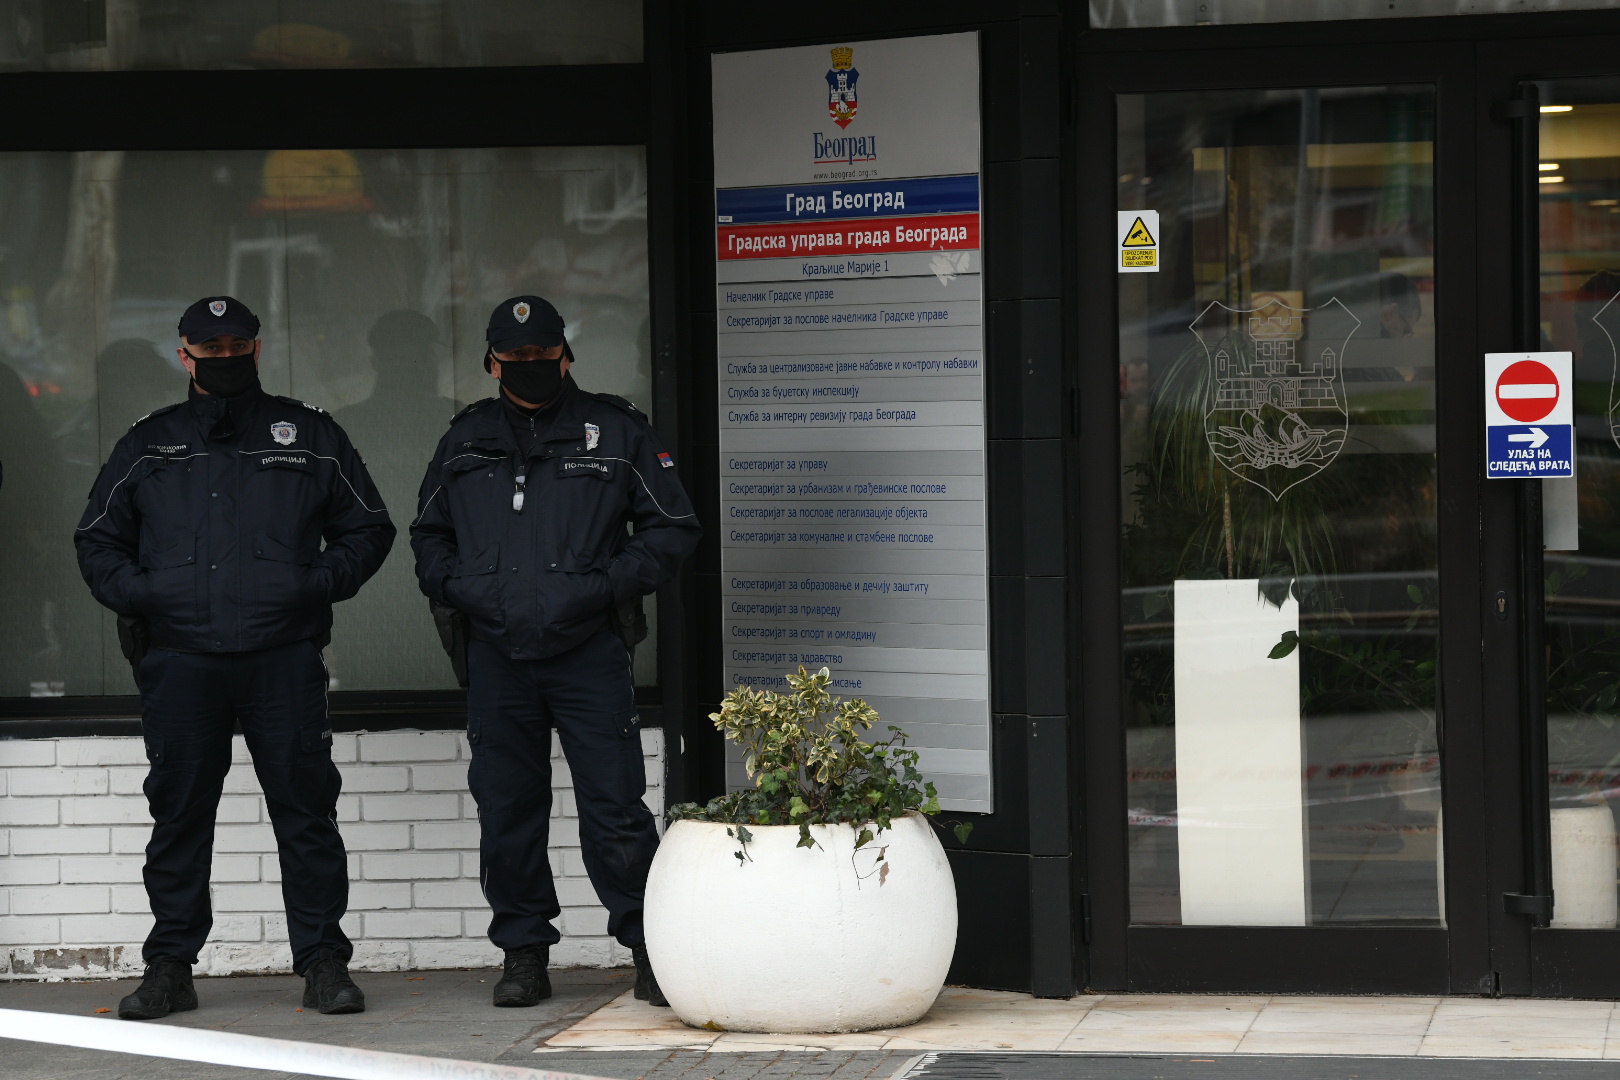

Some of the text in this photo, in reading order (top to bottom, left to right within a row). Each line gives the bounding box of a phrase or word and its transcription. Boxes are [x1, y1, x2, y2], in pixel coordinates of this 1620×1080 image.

[813, 132, 876, 164] Београд
[814, 169, 877, 180] www.beograd.org.rs
[786, 190, 905, 215] Град Београд
[728, 225, 967, 254] Градска управа града Београда
[802, 260, 889, 277] Краљице Марије 1
[727, 289, 834, 303] Начелник Градске управе
[727, 310, 948, 329] Секретаријат за послове начелника Градске управе
[728, 363, 757, 376] Служба
[759, 365, 768, 374] за
[770, 362, 833, 374] централизоване
[836, 360, 857, 374] јавне
[860, 359, 892, 371] набавке
[903, 359, 940, 372] контролу
[943, 358, 978, 369] набавки
[728, 385, 859, 400] Служба за буџетску инспекцију
[728, 408, 915, 424] Служба за интерну ревизију града Београда
[262, 456, 307, 465] ПОЛИЦИЈА
[1508, 449, 1551, 458] УЛАЗ НА
[565, 462, 608, 472] ПОЛИЦИЈА
[729, 459, 827, 472] Секретаријат за управу
[1490, 461, 1570, 472] СЛЕДЕЋА ВРАТА
[730, 483, 784, 496] Секретаријат
[787, 484, 796, 493] за
[798, 483, 843, 495] урбанизам
[854, 483, 908, 496] грађевинске
[911, 484, 946, 493] послове
[730, 507, 927, 520] Секретаријат за послове легализације објекта
[731, 531, 785, 544] Секретаријат
[788, 532, 797, 541] за
[800, 533, 844, 544] комуналне
[855, 532, 895, 543] стамбене
[898, 534, 933, 543] послове
[732, 578, 786, 591] Секретаријат
[789, 580, 797, 589] за
[801, 579, 852, 593] образовање
[863, 581, 890, 594] дечију
[893, 582, 928, 594] заштиту
[732, 602, 840, 618] Секретаријат за привреду
[732, 626, 786, 639] Секретаријат
[789, 628, 798, 637] за
[801, 629, 824, 641] спорт
[835, 630, 877, 642] омладину
[733, 650, 842, 665] Секретаријат за здравство
[733, 674, 787, 688] Секретаријат
